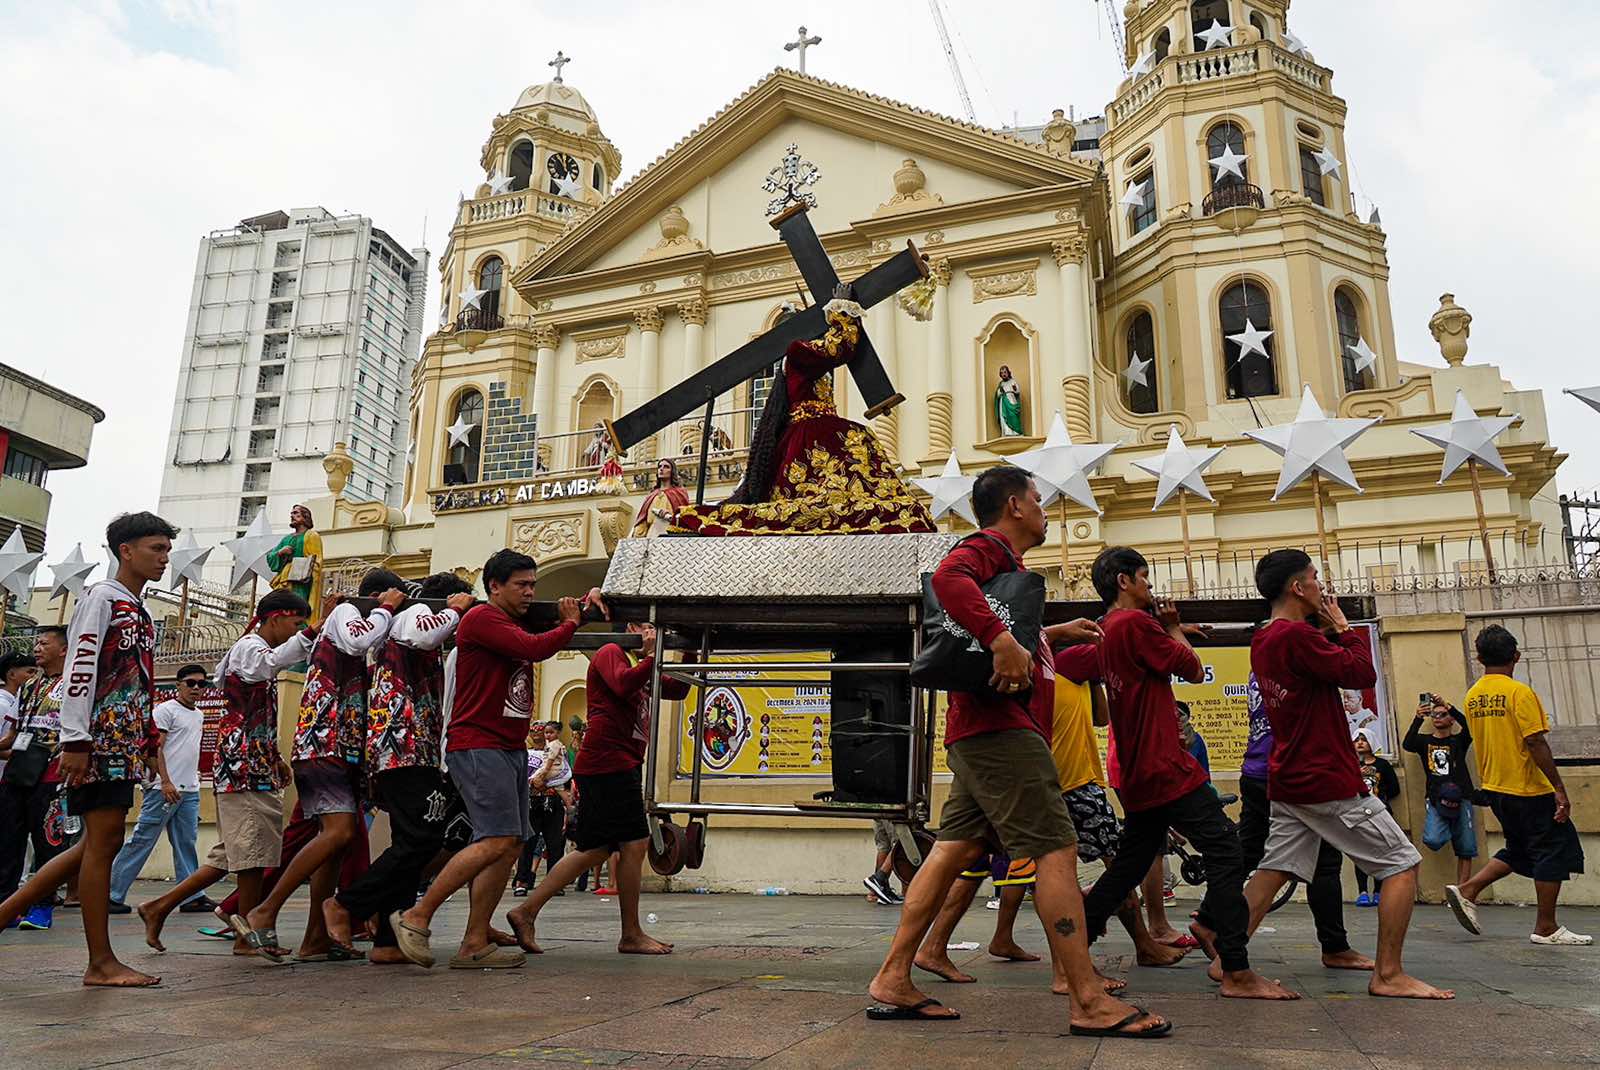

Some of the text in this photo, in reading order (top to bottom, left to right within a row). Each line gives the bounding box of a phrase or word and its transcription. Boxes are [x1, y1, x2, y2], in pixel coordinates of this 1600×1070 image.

[515, 484, 537, 501] AT
[541, 477, 602, 500] DAMBA
[68, 633, 98, 698] KALBS
